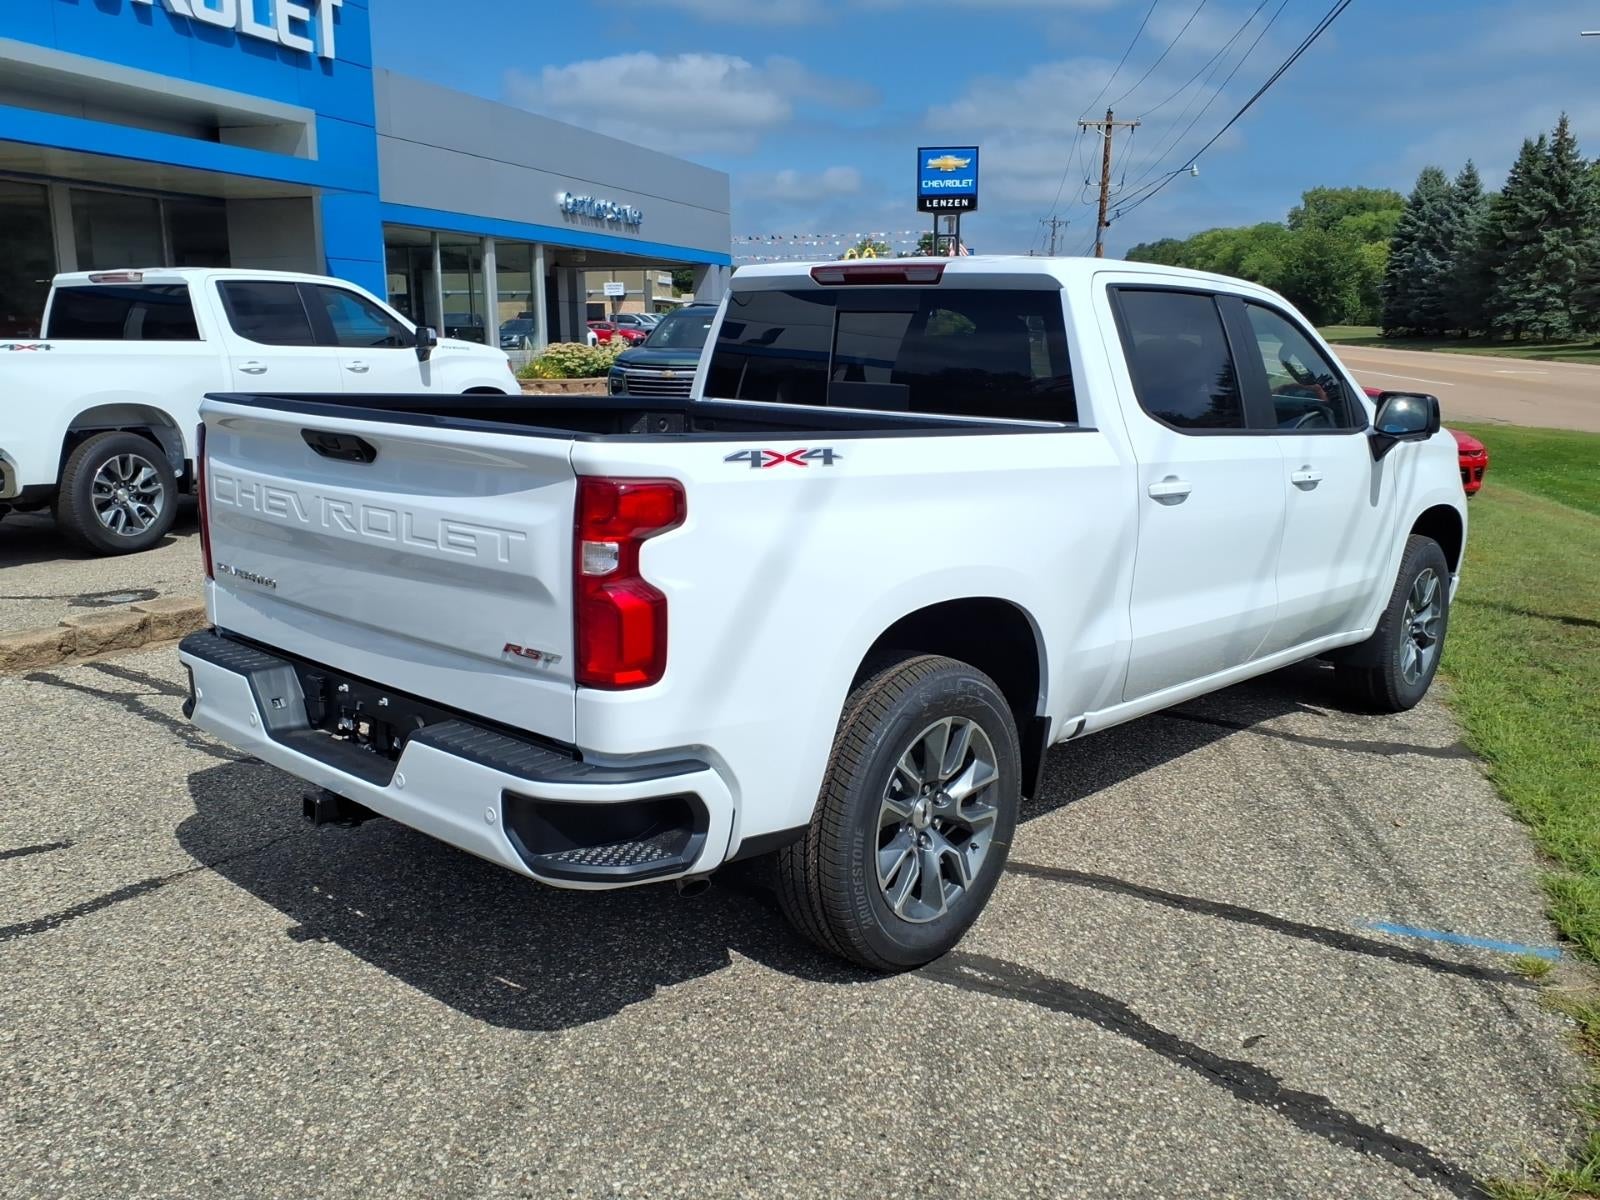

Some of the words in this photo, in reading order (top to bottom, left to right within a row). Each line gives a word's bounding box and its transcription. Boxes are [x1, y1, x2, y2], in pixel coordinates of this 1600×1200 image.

[130, 0, 343, 59] LET
[922, 179, 973, 188] CHEVROLET
[926, 199, 969, 207] LENZEN
[213, 474, 527, 563] CHEVROLET
[502, 642, 563, 669] RST
